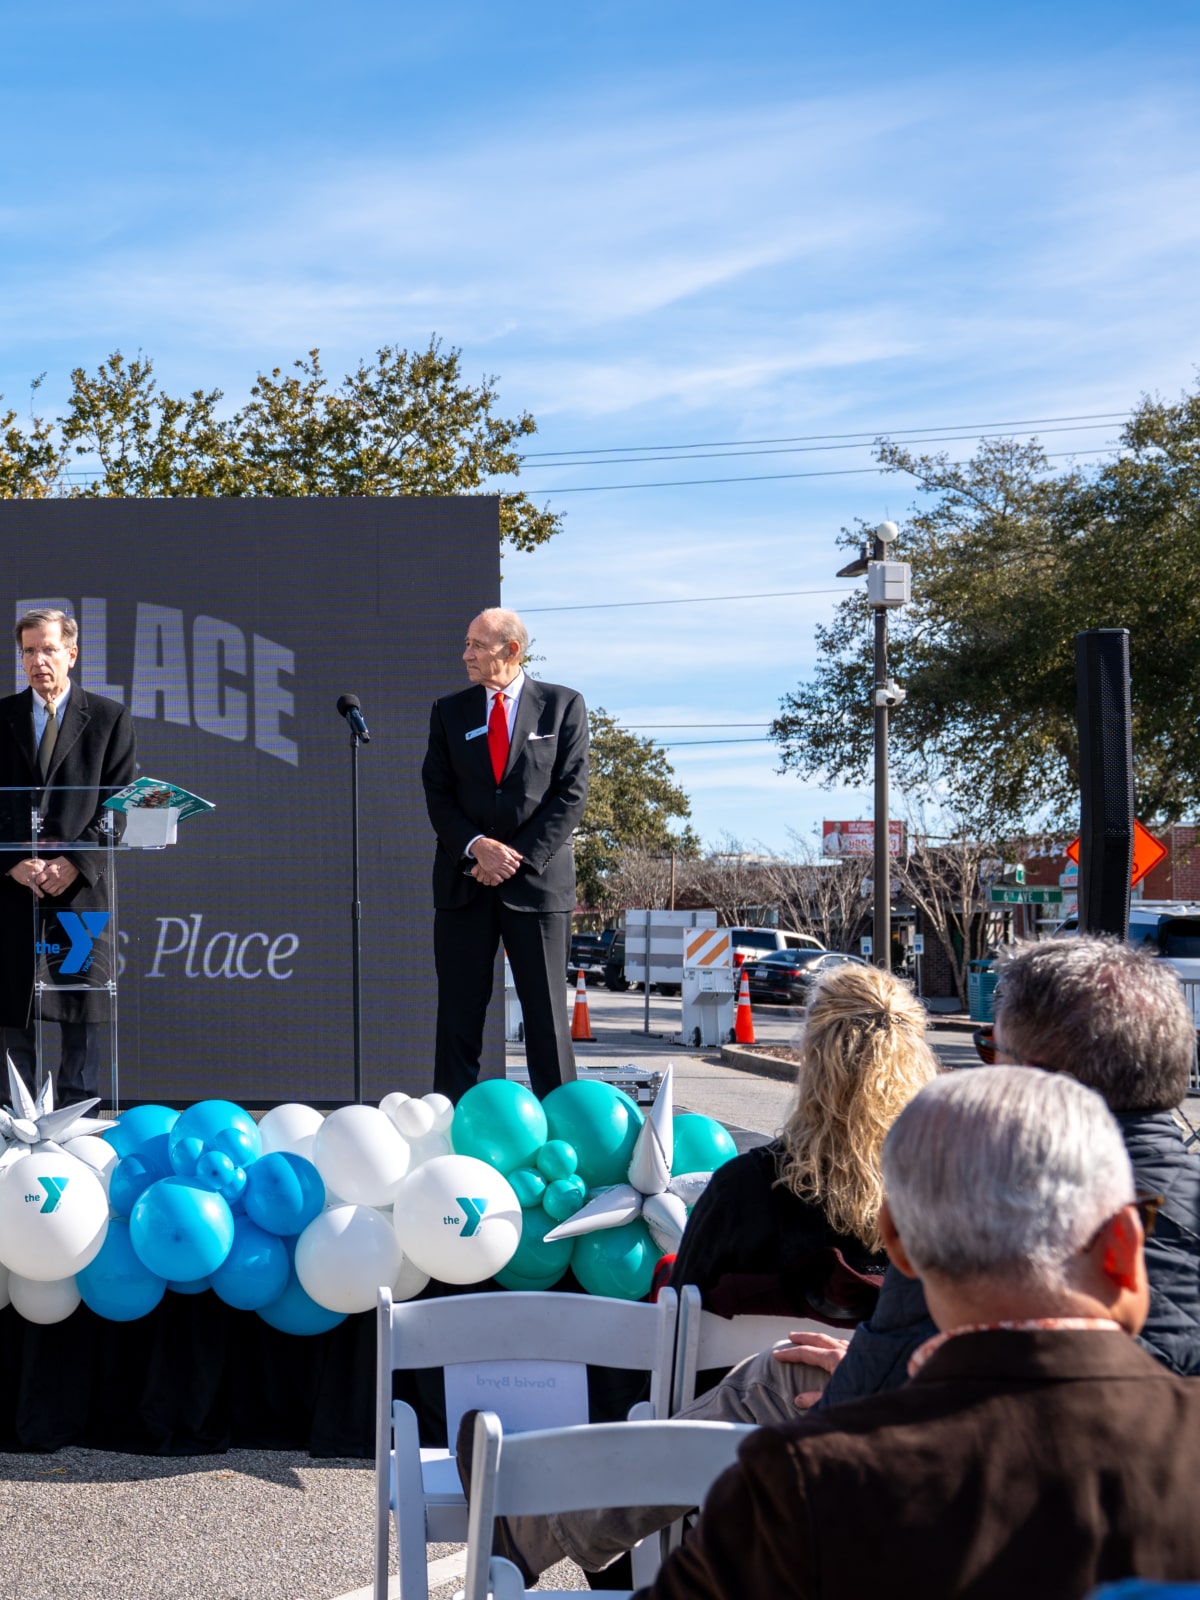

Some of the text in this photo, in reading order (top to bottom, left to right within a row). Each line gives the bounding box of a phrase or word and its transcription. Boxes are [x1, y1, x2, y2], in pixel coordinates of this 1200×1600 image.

[1017, 892, 1033, 903] AVE
[1043, 892, 1050, 902] N
[35, 940, 60, 954] the
[144, 914, 299, 980] Place
[24, 1193, 41, 1203] the
[443, 1215, 460, 1225] the
